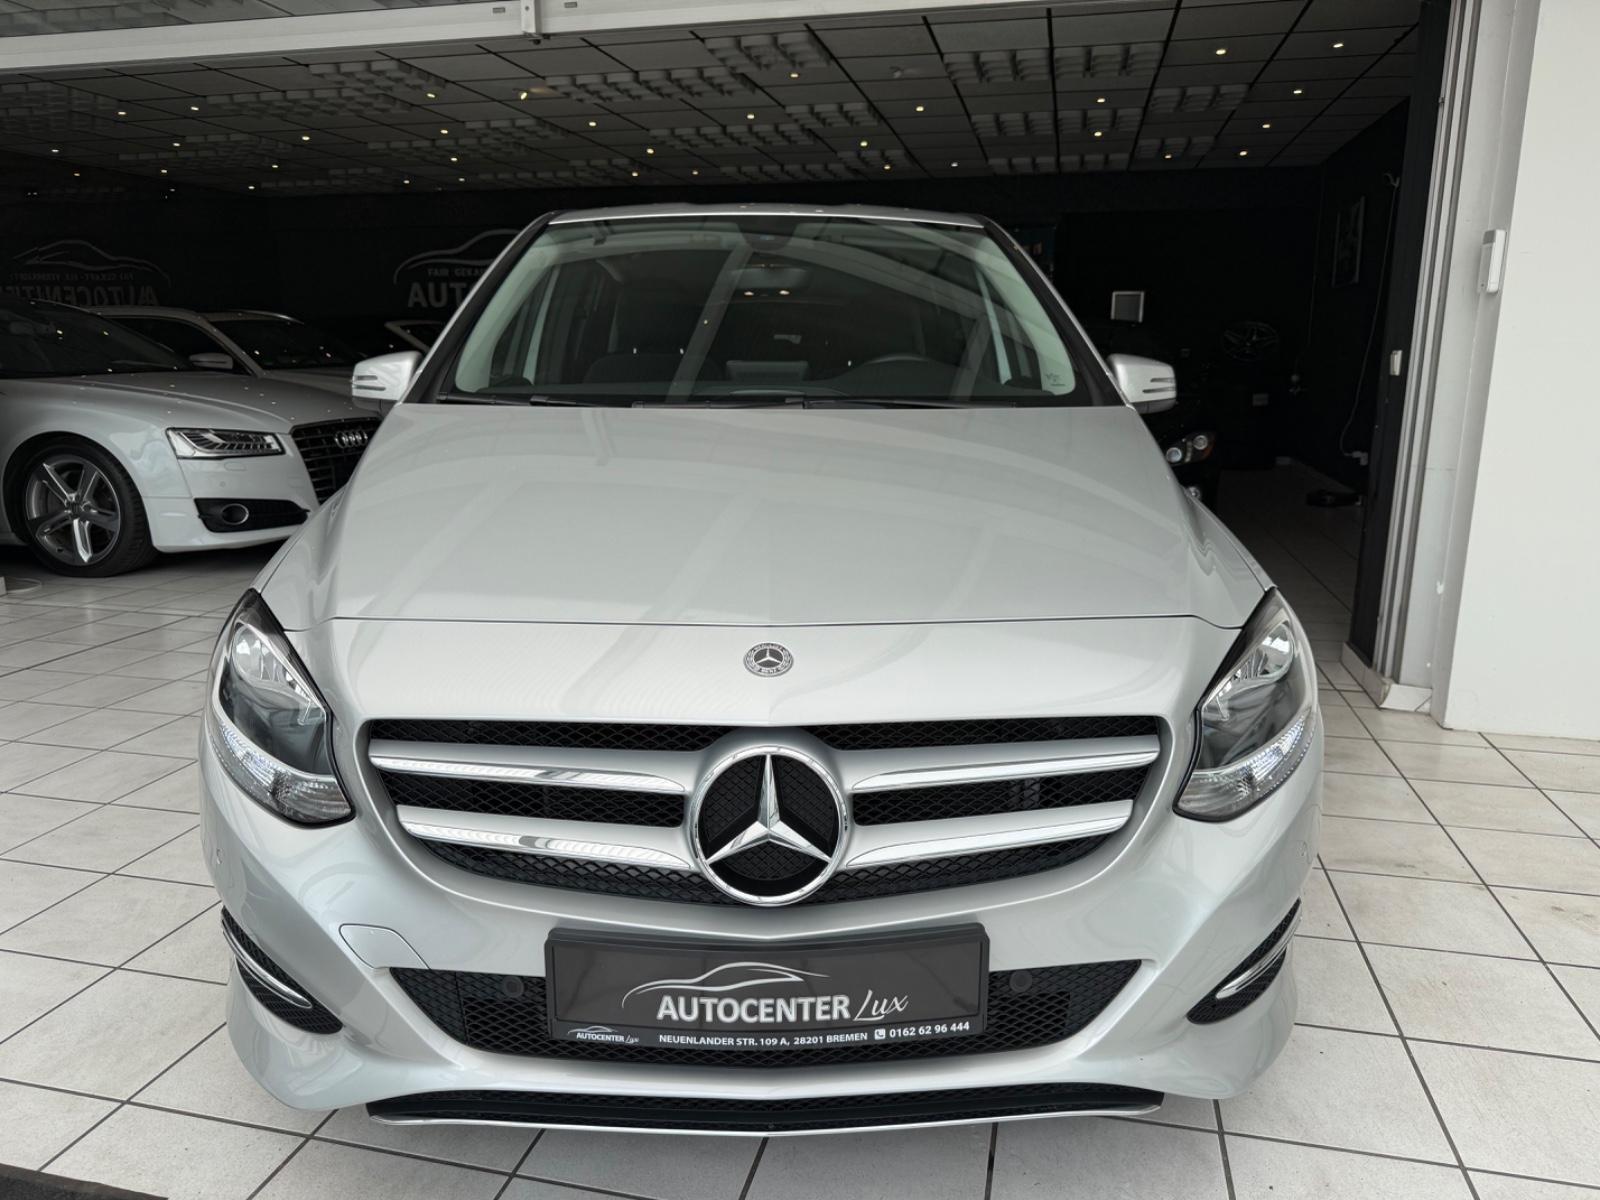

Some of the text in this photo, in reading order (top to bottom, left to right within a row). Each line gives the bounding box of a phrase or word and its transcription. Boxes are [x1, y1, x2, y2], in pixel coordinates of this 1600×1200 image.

[428, 268, 449, 277] FA
[408, 282, 469, 308] AUT
[656, 989, 909, 1023] AUTOCENTER Lux
[576, 1032, 625, 1043] AUTOCENTER
[659, 1021, 970, 1046] NEUENLANDER STR. 109 A, 28201 BREMEN 0162 62 96 444
